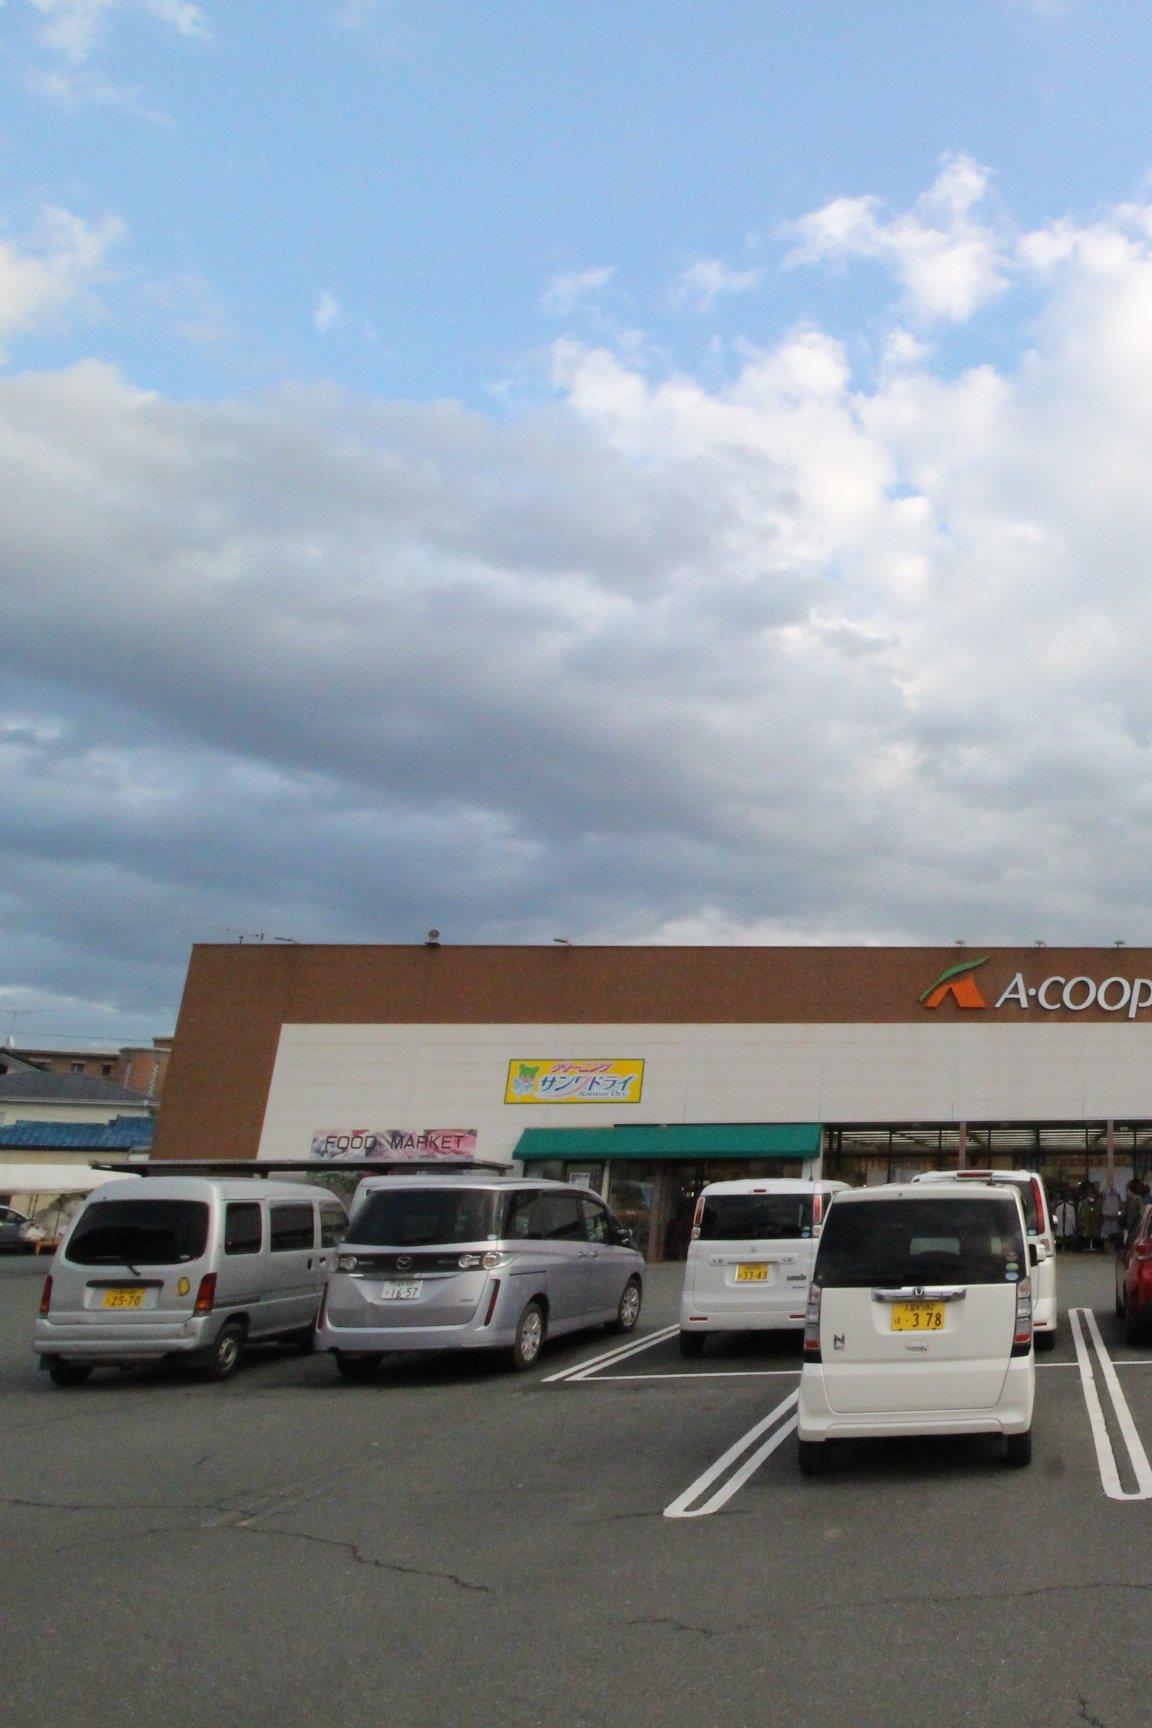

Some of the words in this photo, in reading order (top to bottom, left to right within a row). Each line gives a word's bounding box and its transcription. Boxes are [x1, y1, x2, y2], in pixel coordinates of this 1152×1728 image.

[550, 1062, 614, 1073] クリーニング
[540, 1075, 636, 1095] サンワドライ
[325, 1135, 377, 1150] FOOD
[390, 1135, 466, 1150] MARKET
